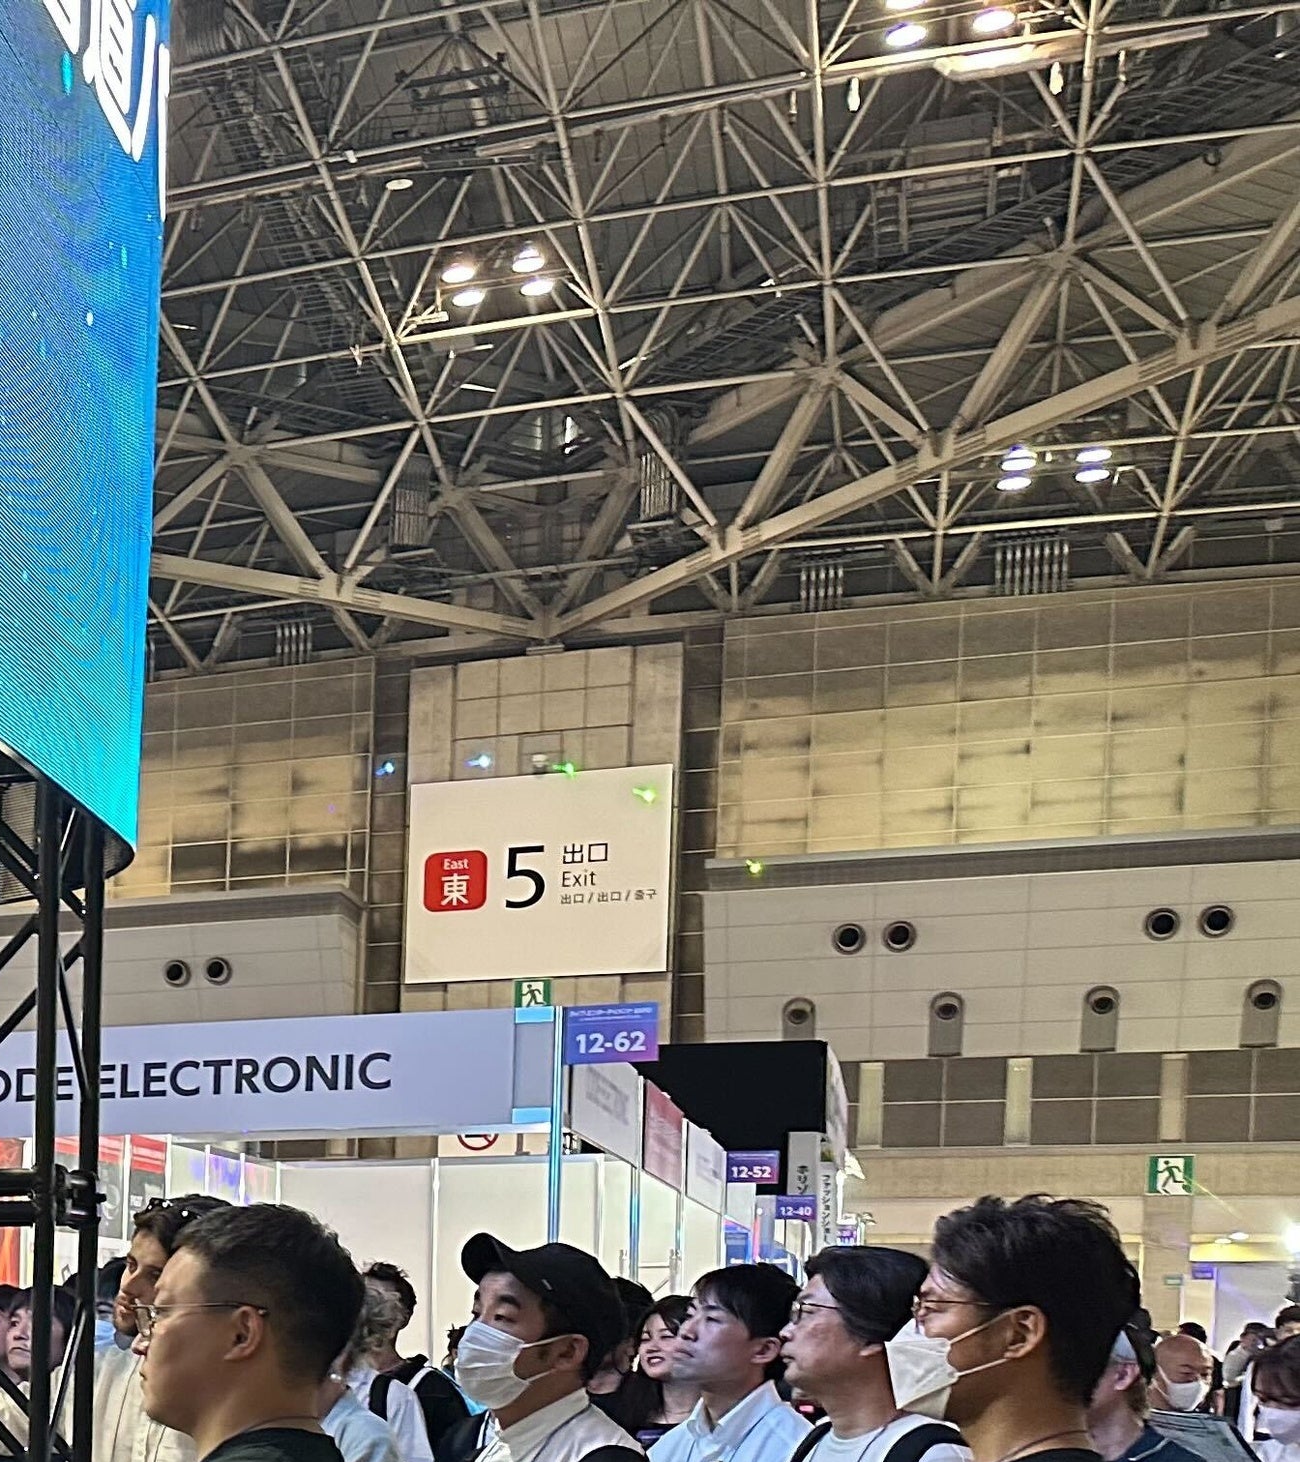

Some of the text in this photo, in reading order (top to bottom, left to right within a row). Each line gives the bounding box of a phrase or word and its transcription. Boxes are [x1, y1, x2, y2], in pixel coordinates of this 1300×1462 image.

[562, 843, 609, 864] 出口
[443, 858, 469, 870] East
[505, 845, 546, 908] 5
[561, 871, 597, 887] Exit
[440, 873, 470, 906] 東
[560, 893, 584, 905] 出口
[597, 891, 622, 903] 出口
[634, 889, 658, 901] 출구
[575, 1030, 647, 1054] 12-62
[100, 1052, 393, 1099] ELECTRONIC
[731, 1165, 772, 1179] 12-52
[780, 1206, 812, 1217] 12-40
